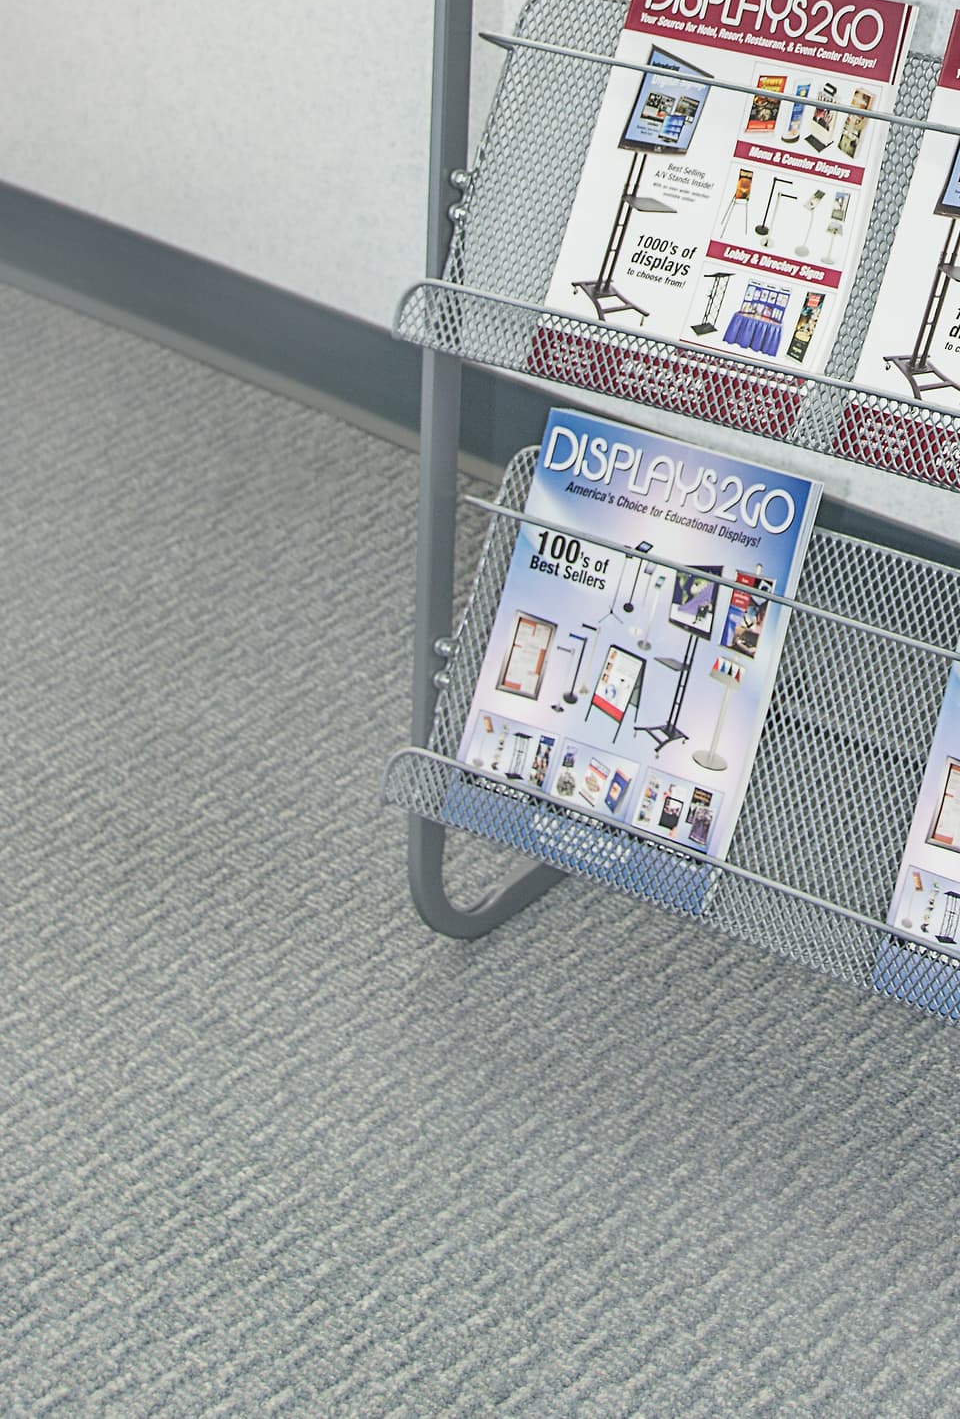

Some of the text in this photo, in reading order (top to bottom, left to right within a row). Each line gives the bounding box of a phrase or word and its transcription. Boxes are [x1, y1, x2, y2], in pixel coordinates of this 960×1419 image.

[637, 234, 698, 260] 1000's of
[627, 268, 686, 289] to choose from!
[631, 250, 691, 277] displays
[944, 341, 953, 351] to
[543, 425, 796, 535] DISPLAYS2GO
[565, 481, 762, 549] America's Choice for Educational Displays!
[538, 530, 611, 575] 100's of
[529, 555, 607, 591] Best Sellers
